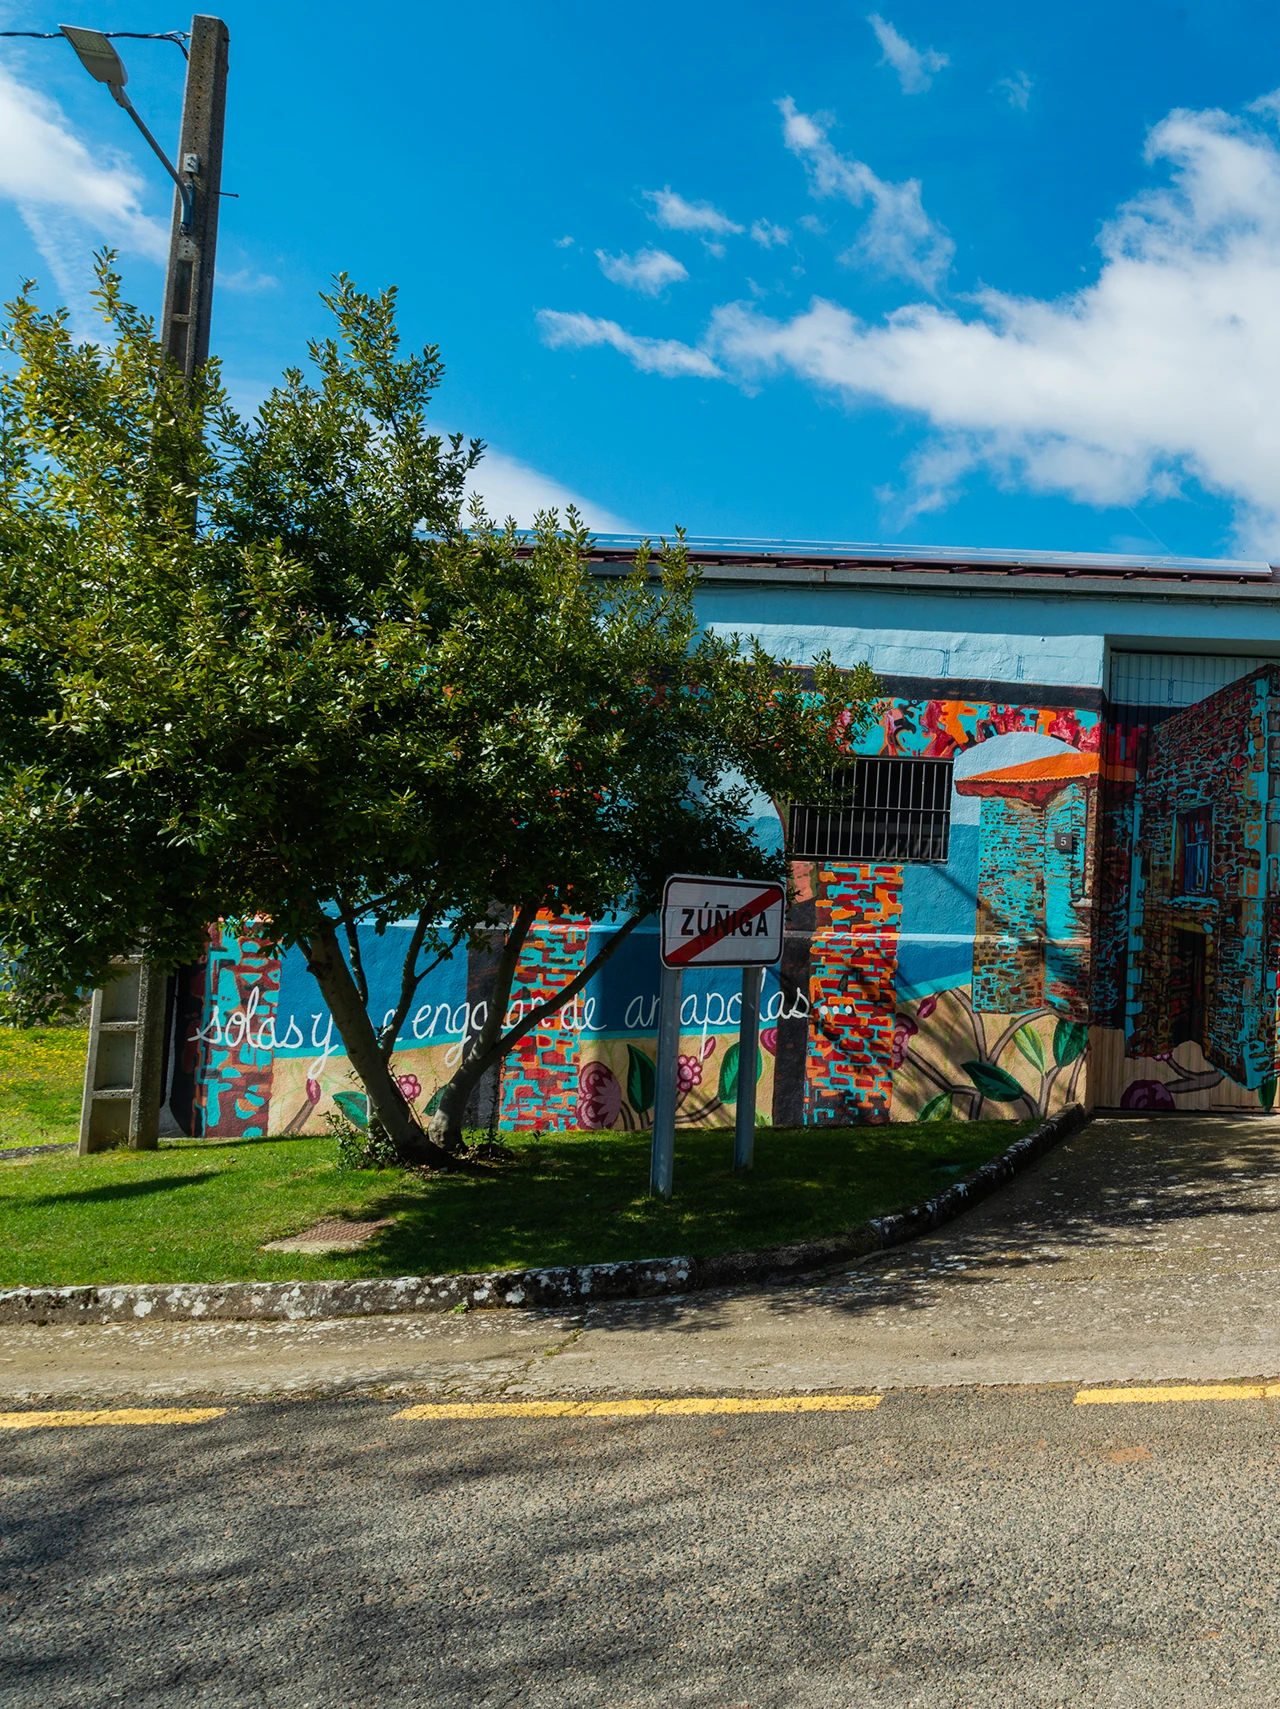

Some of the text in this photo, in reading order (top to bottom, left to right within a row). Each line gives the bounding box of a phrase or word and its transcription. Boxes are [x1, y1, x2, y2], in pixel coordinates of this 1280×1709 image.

[1060, 836, 1067, 846] 5
[680, 902, 769, 936] ZÚÑIGA
[187, 986, 304, 1050] solas
[307, 1012, 340, 1080] y
[560, 993, 608, 1031] de
[624, 966, 854, 1065] aapoas...
